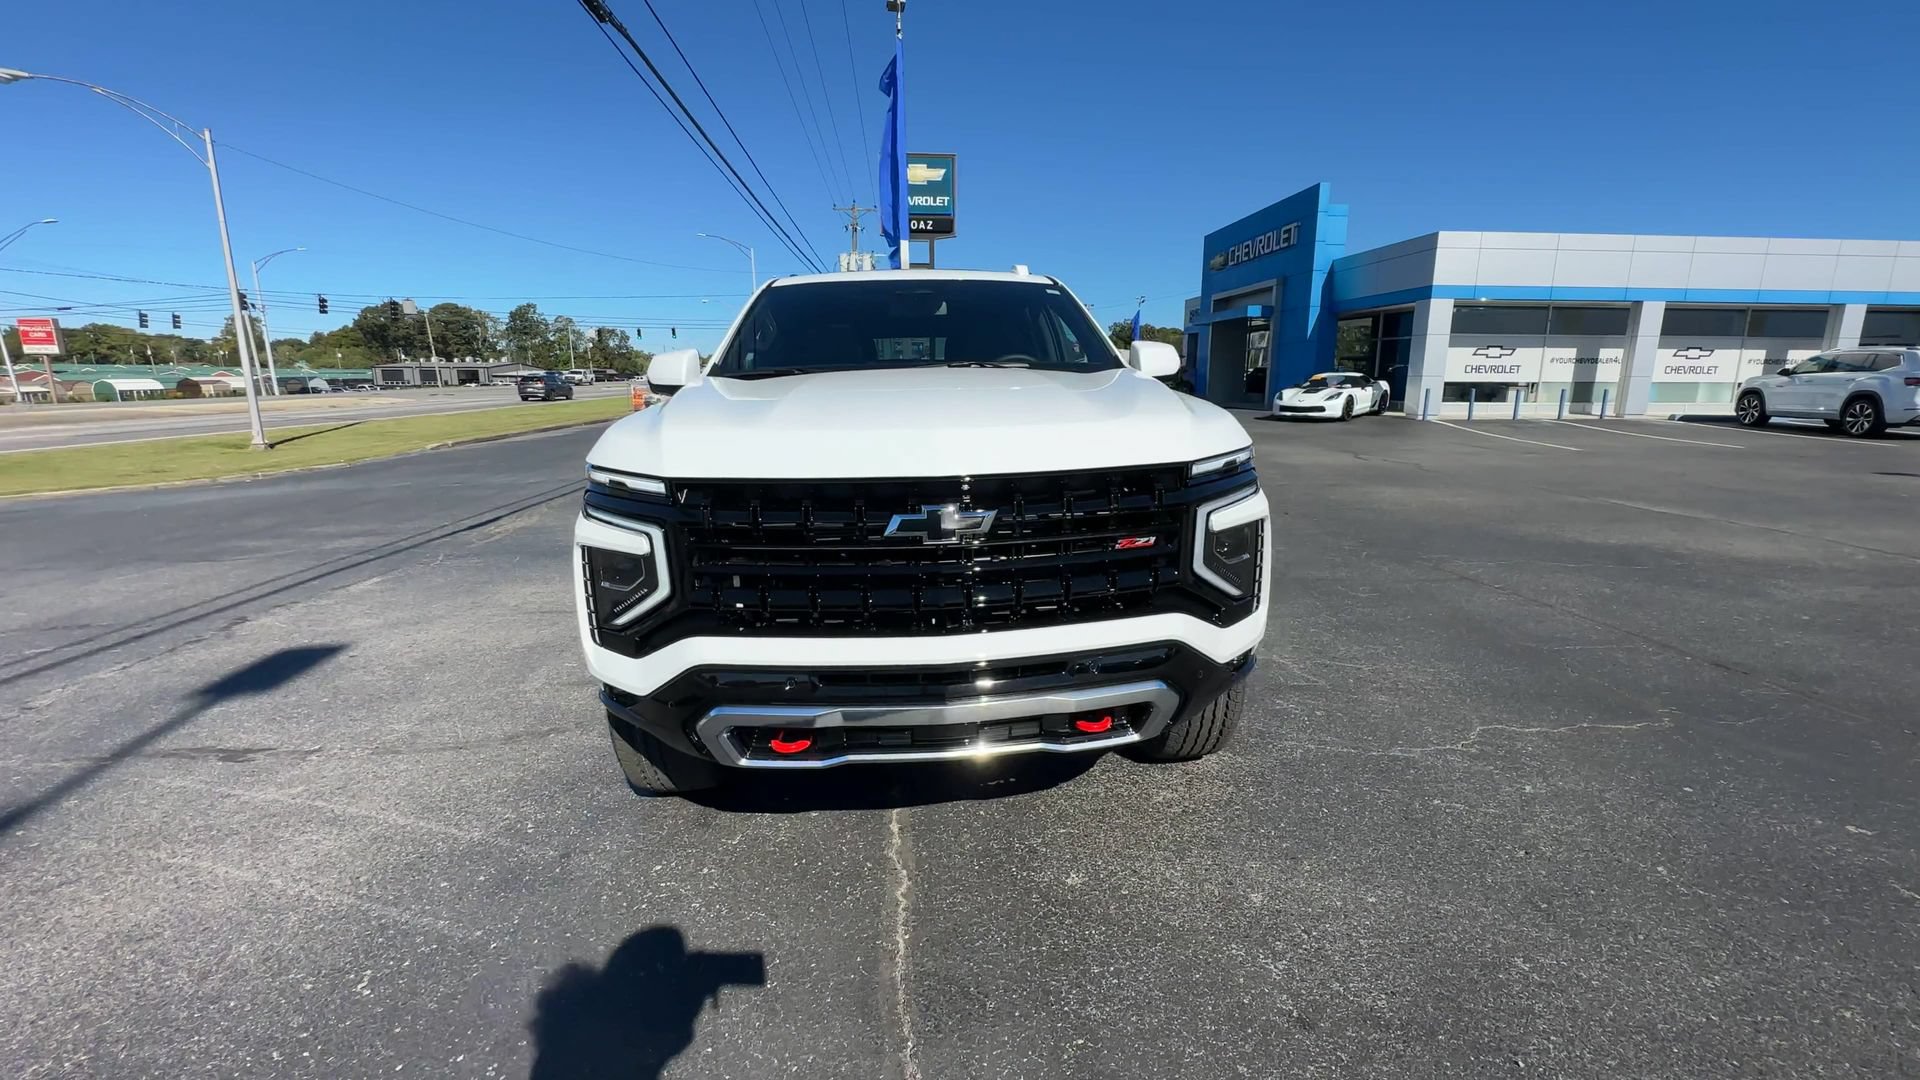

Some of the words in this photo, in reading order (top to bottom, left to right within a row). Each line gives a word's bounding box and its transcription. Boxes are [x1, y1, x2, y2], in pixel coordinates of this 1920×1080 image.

[1228, 223, 1297, 265] CHEVROLET
[1464, 365, 1521, 374] CHEVROLET
[1664, 365, 1718, 375] CHEVROLET
